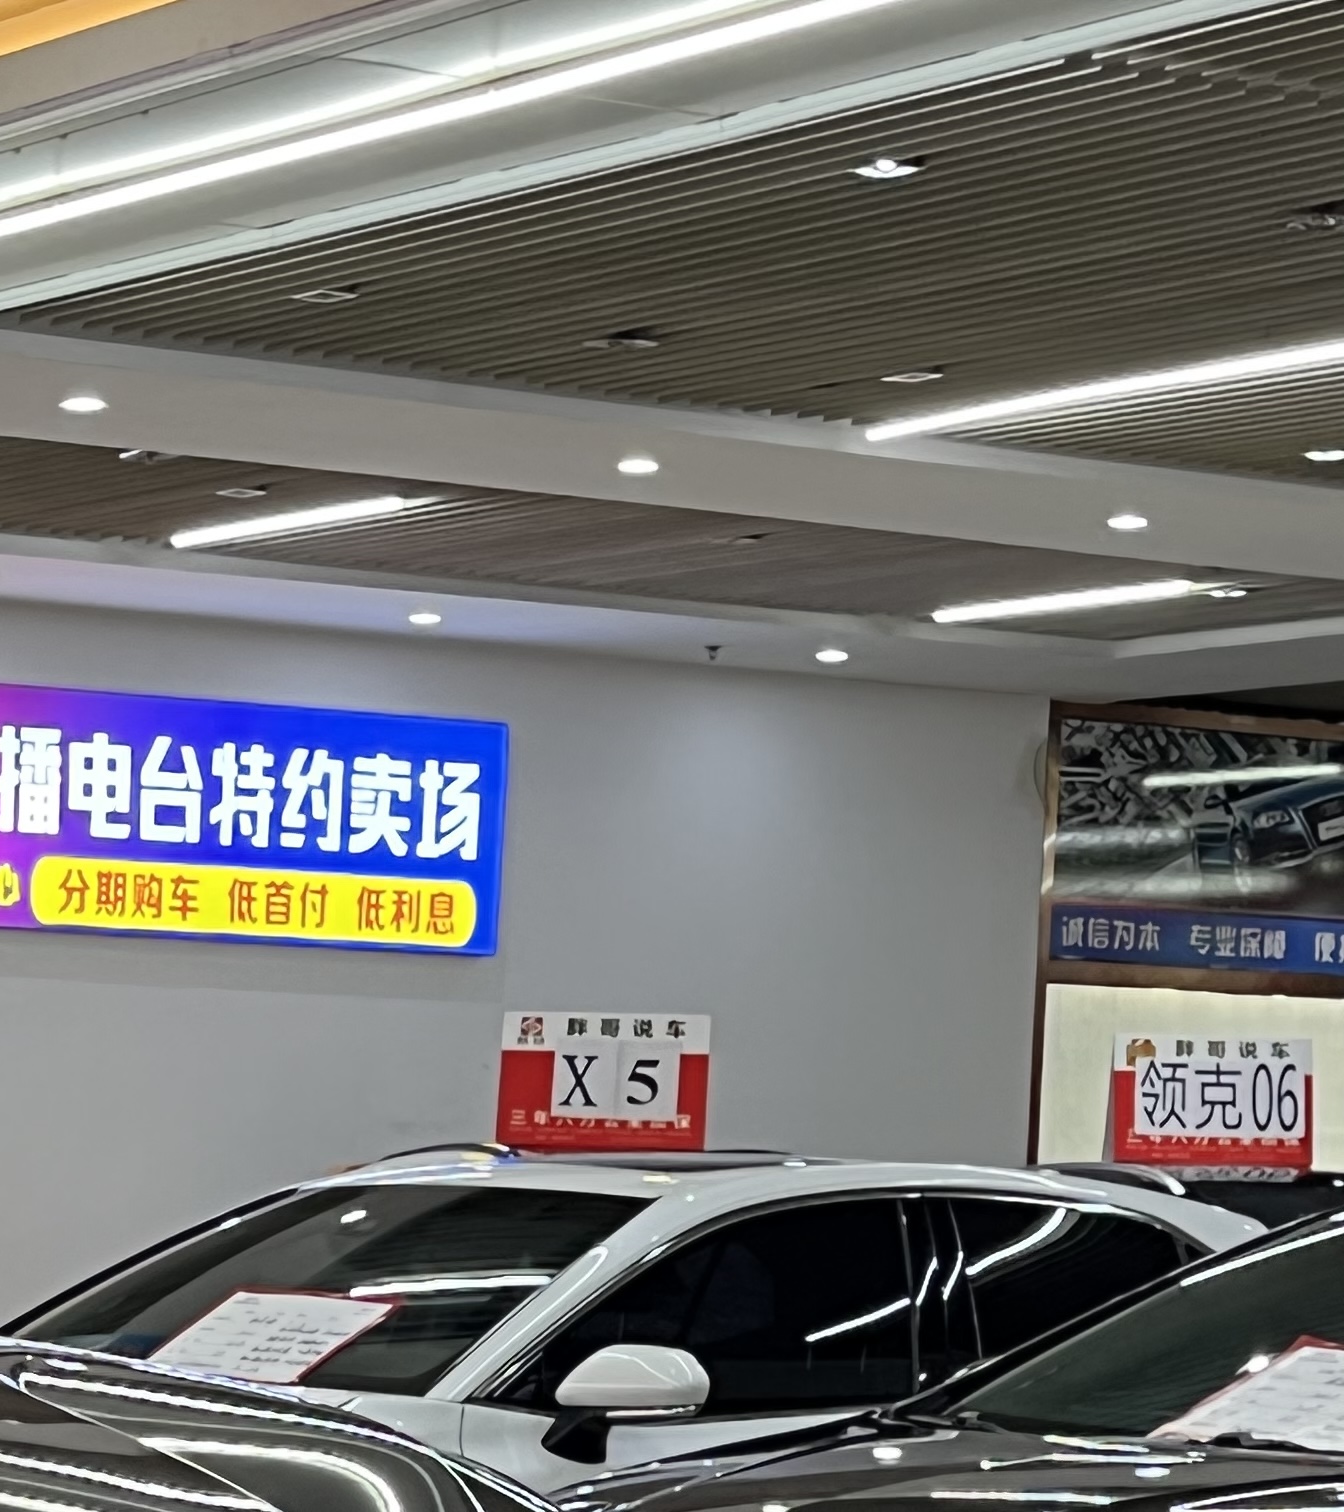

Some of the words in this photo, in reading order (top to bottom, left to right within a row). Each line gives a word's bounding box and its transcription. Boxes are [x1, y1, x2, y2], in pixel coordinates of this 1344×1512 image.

[57, 867, 201, 921] 分期购车
[227, 880, 328, 930] 低首付
[355, 885, 458, 937] 低利息
[1061, 916, 1161, 951] 诚信为本
[1140, 1060, 1299, 1132] 领克06
